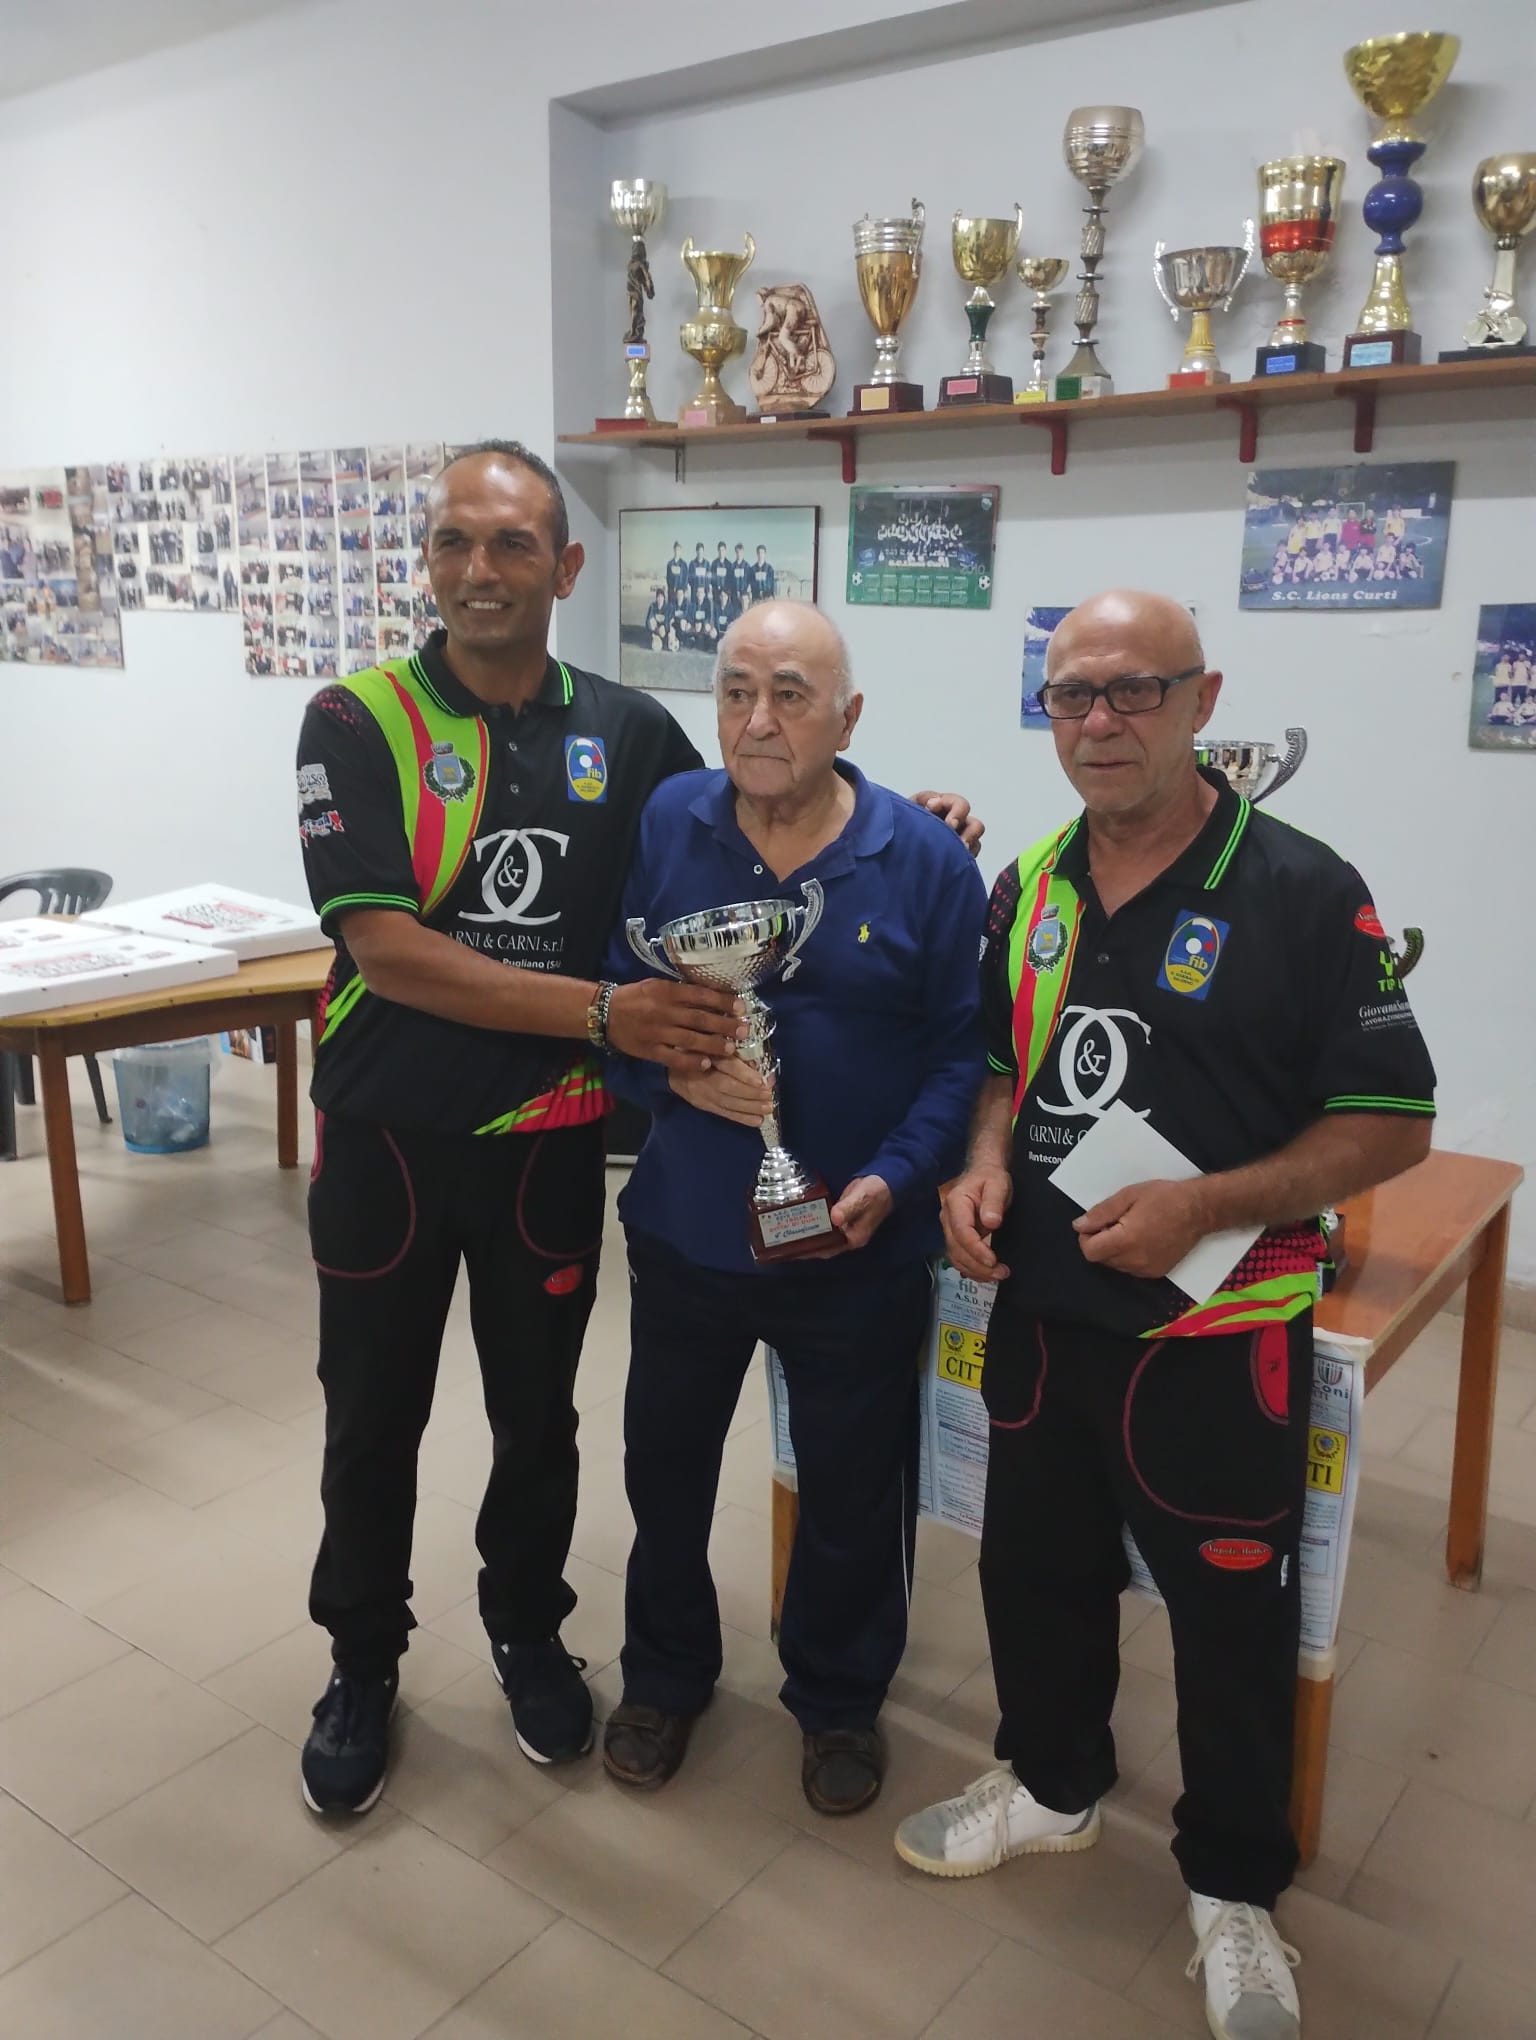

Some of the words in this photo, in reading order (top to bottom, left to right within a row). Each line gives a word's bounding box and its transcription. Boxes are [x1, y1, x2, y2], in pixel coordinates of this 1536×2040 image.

[1271, 590, 1301, 601] S.C.
[1306, 589, 1348, 601] Lions
[1352, 589, 1397, 601] Curti
[482, 933, 494, 949] &
[497, 933, 540, 951] CARNI
[502, 957, 545, 969] Pugliano
[1029, 1124, 1062, 1145] CARNI
